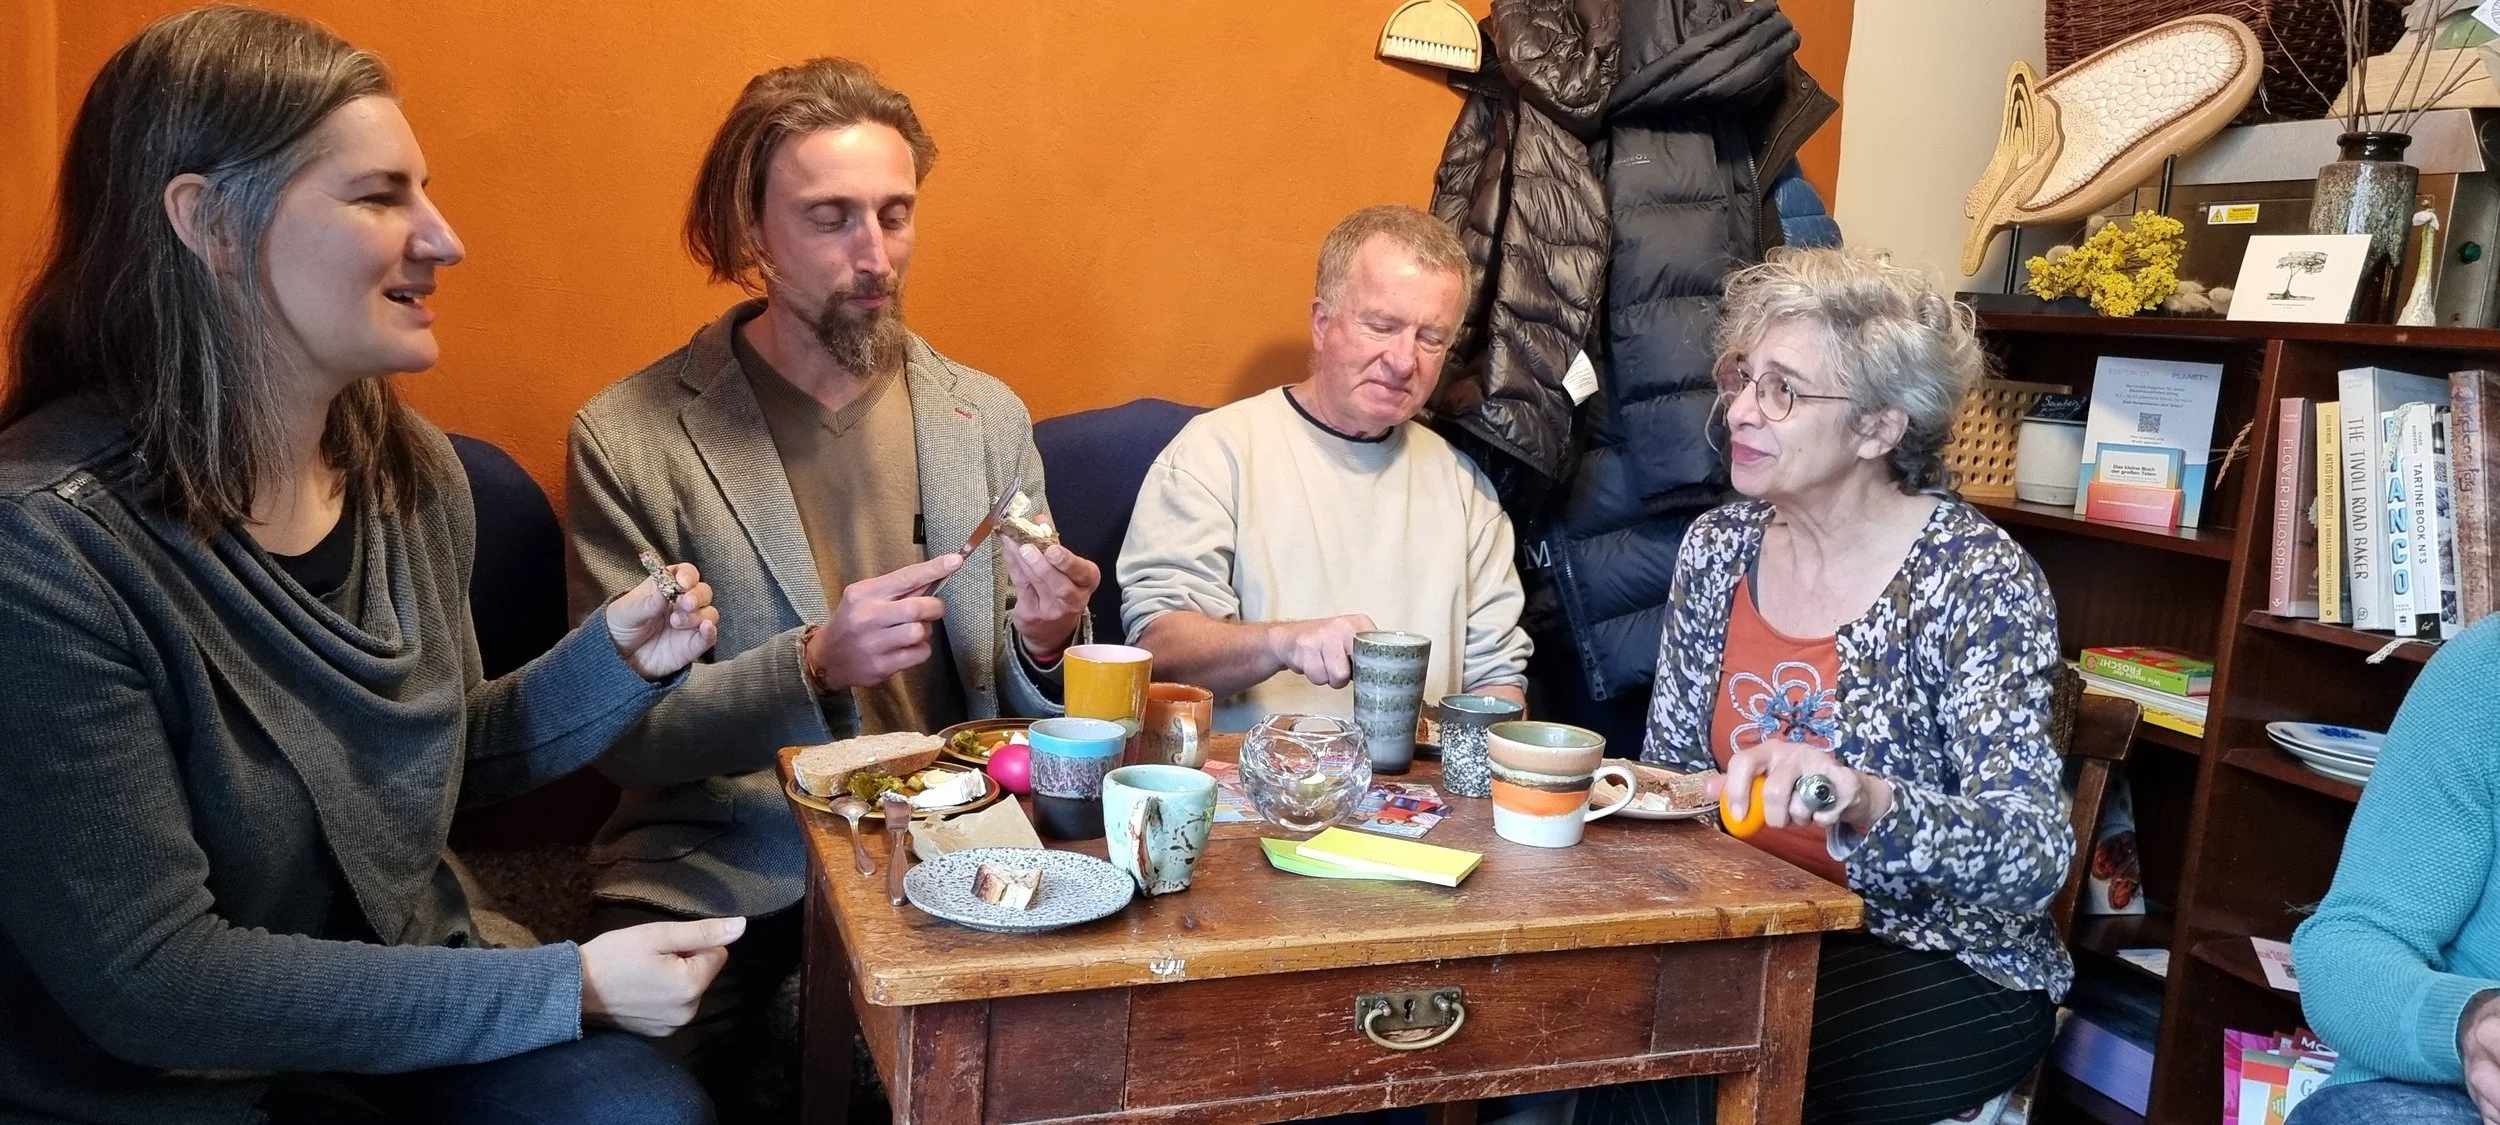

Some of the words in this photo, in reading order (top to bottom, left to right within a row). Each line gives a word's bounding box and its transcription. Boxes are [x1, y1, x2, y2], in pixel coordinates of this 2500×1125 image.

[2348, 416, 2365, 444] THE
[2280, 439, 2293, 494] FLOWER
[2324, 453, 2333, 474] ANTICO
[2349, 449, 2367, 491] TIVOLI
[2324, 475, 2333, 494] FORNO
[2413, 463, 2425, 507] TARTINE
[2324, 494, 2333, 520] ROSCIOLI
[2352, 497, 2368, 532] ROAD
[2416, 509, 2426, 540] BOOK
[2275, 499, 2289, 582] PHILOSOPHY
[2353, 537, 2369, 580] BAKER
[2125, 671, 2146, 682] macht
[2147, 678, 2161, 687] Wie
